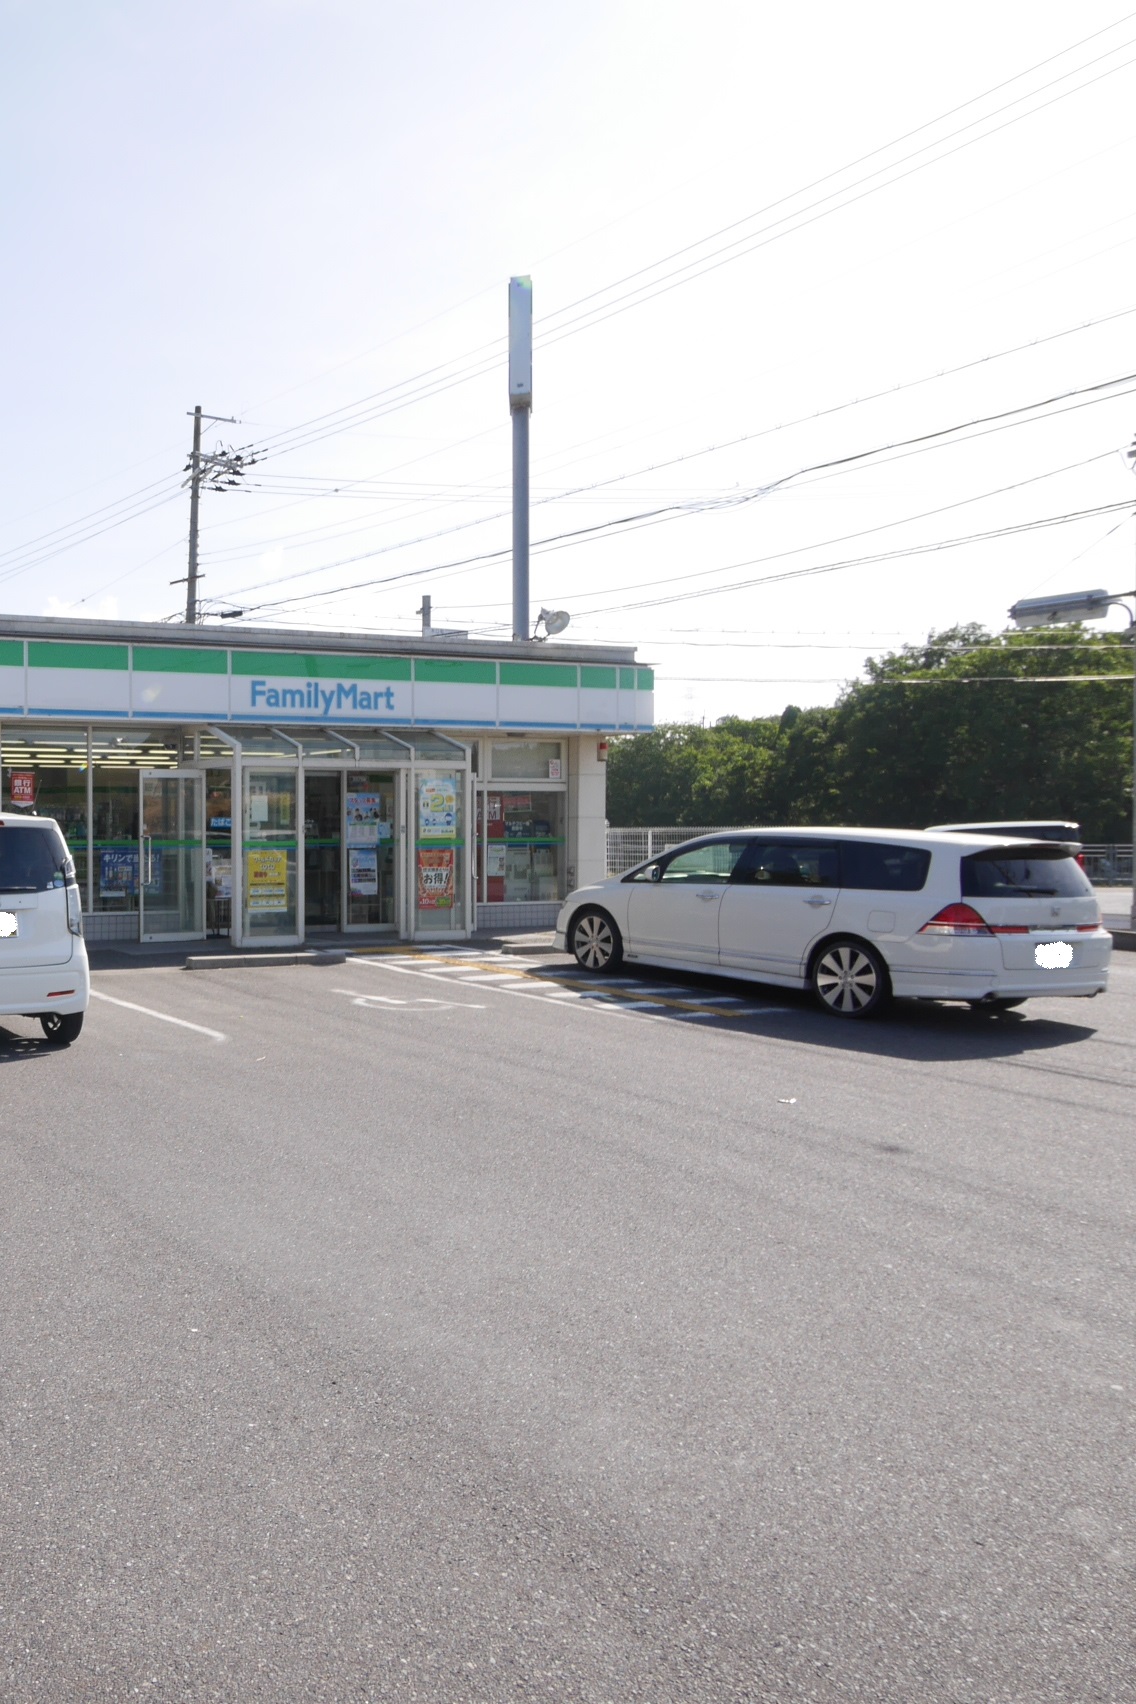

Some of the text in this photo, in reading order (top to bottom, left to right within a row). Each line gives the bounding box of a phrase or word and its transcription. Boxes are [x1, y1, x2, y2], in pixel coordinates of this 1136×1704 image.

[250, 680, 395, 716] FamilyMart
[14, 786, 31, 794] ATM
[424, 873, 448, 884] お得!
